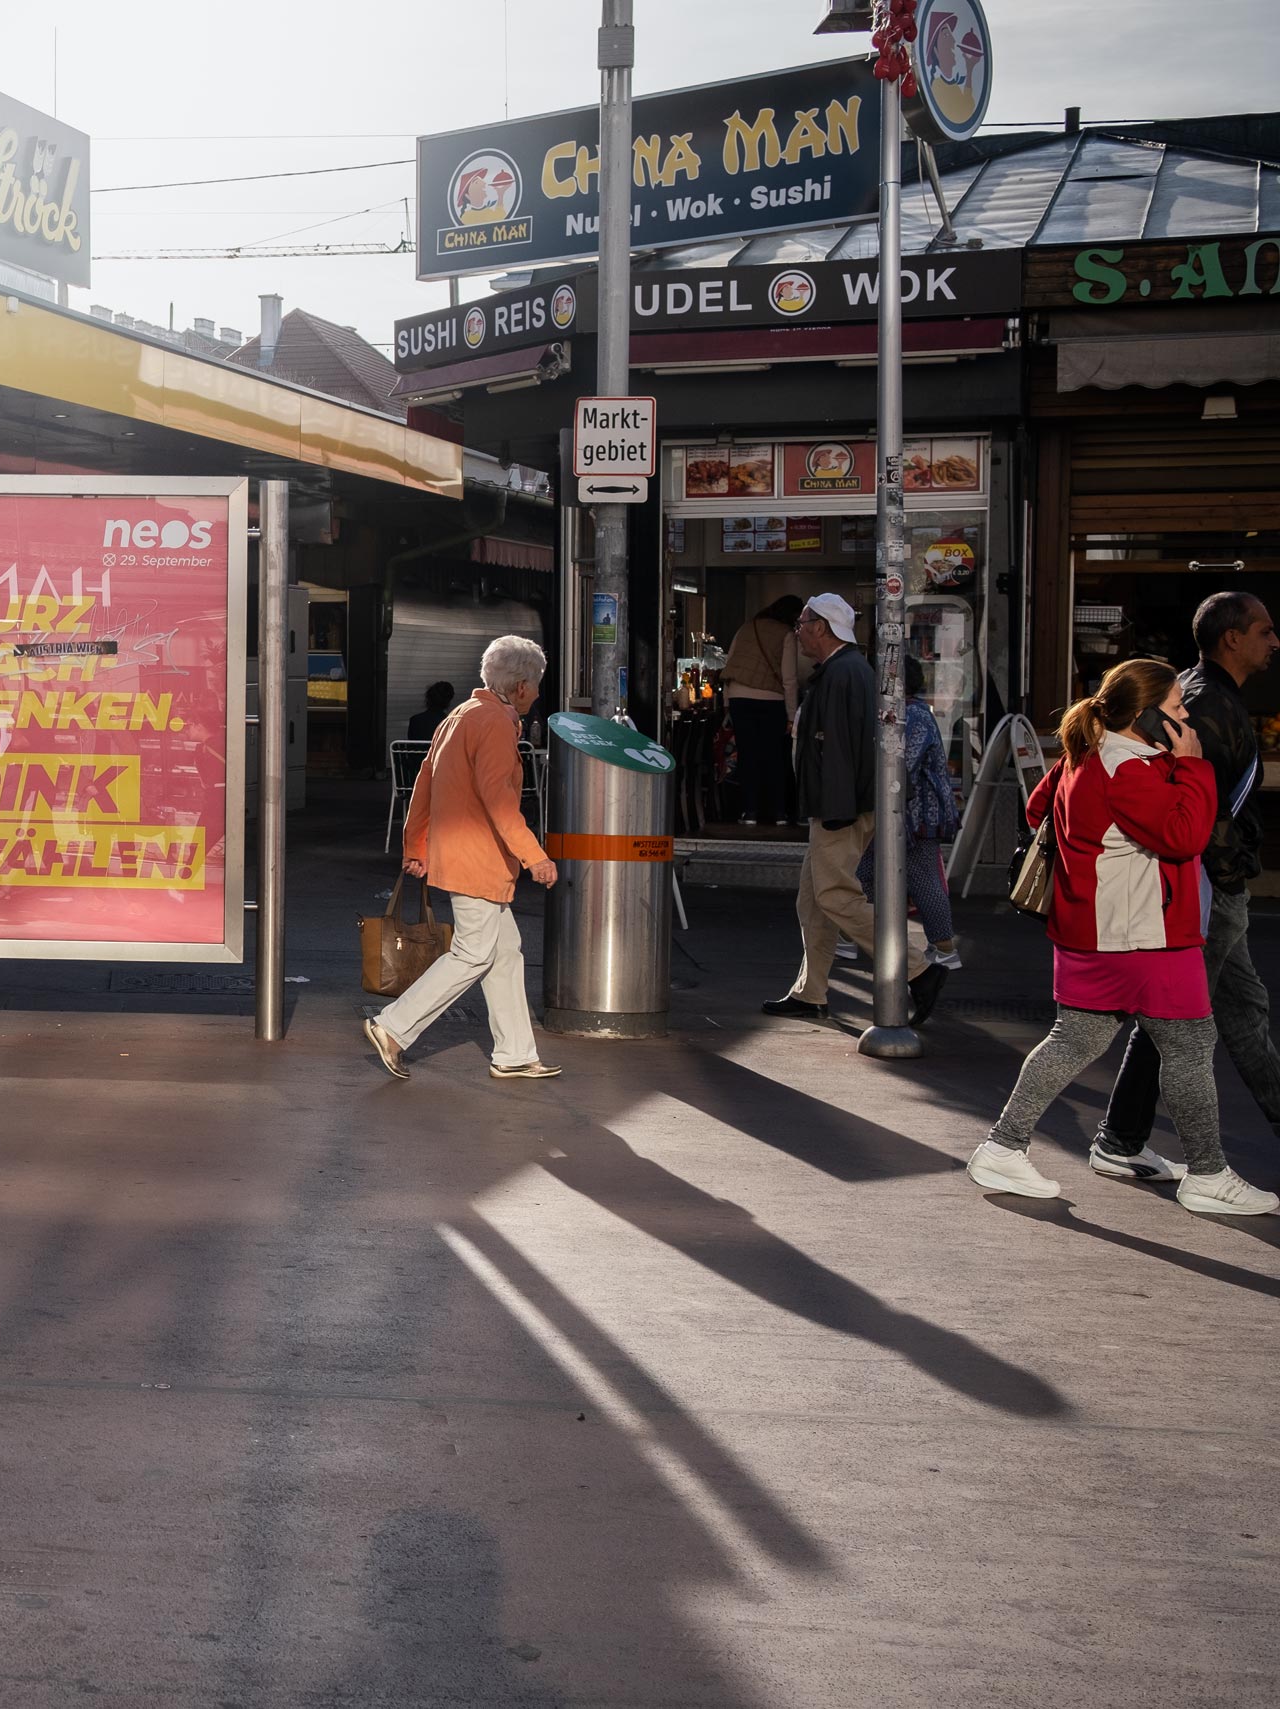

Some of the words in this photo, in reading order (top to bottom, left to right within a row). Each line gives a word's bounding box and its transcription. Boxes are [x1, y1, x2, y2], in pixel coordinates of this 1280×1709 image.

[541, 131, 701, 200] CHNA
[722, 95, 862, 176] MAN
[566, 203, 641, 237] Nul
[665, 193, 724, 223] Wok
[750, 176, 832, 210] Sushi
[444, 230, 487, 249] CHINA
[493, 223, 527, 243] MAN
[634, 279, 753, 318] UDEL
[494, 297, 546, 337] REIS
[397, 318, 457, 359] SUSHI
[582, 406, 649, 430] Markt-
[582, 438, 647, 466] gebiet
[803, 479, 833, 489] CHINA
[102, 517, 213, 549] neos
[120, 554, 139, 567] 29.
[141, 554, 213, 569] September
[944, 548, 969, 558] BOX
